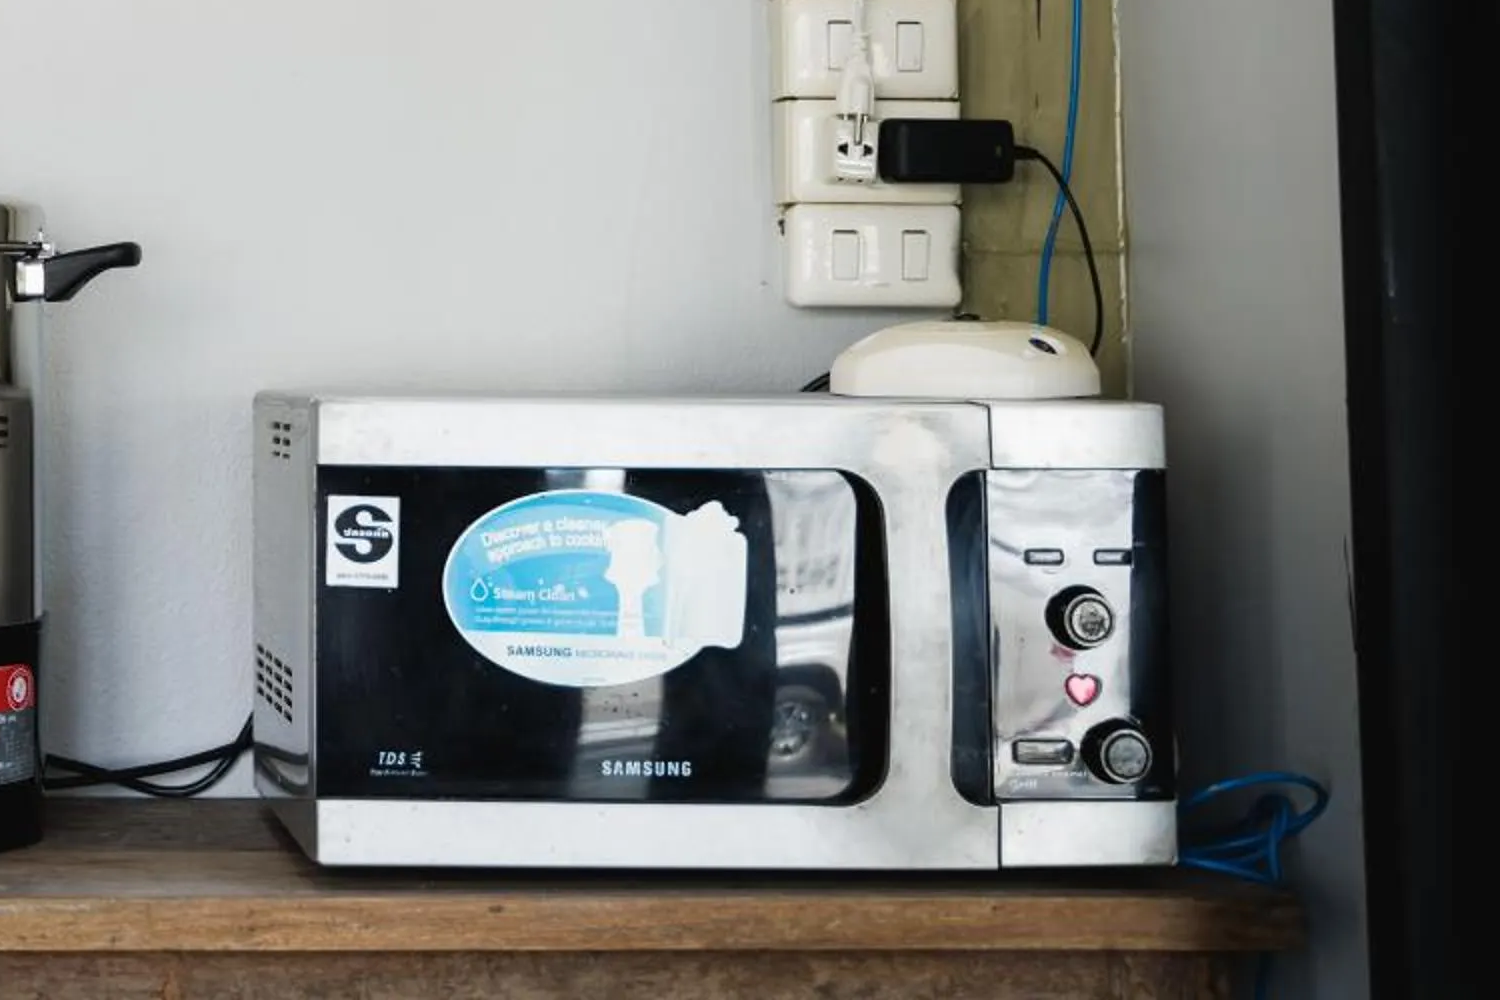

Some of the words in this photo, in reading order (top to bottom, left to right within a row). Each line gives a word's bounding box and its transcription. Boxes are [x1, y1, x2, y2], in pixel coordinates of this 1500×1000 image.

[481, 521, 540, 547] Discover
[549, 534, 563, 548] to
[493, 587, 536, 601] Steam
[538, 587, 576, 601] Clean
[506, 645, 573, 658] SAMSUNG
[602, 760, 692, 777] SAMSUNG
